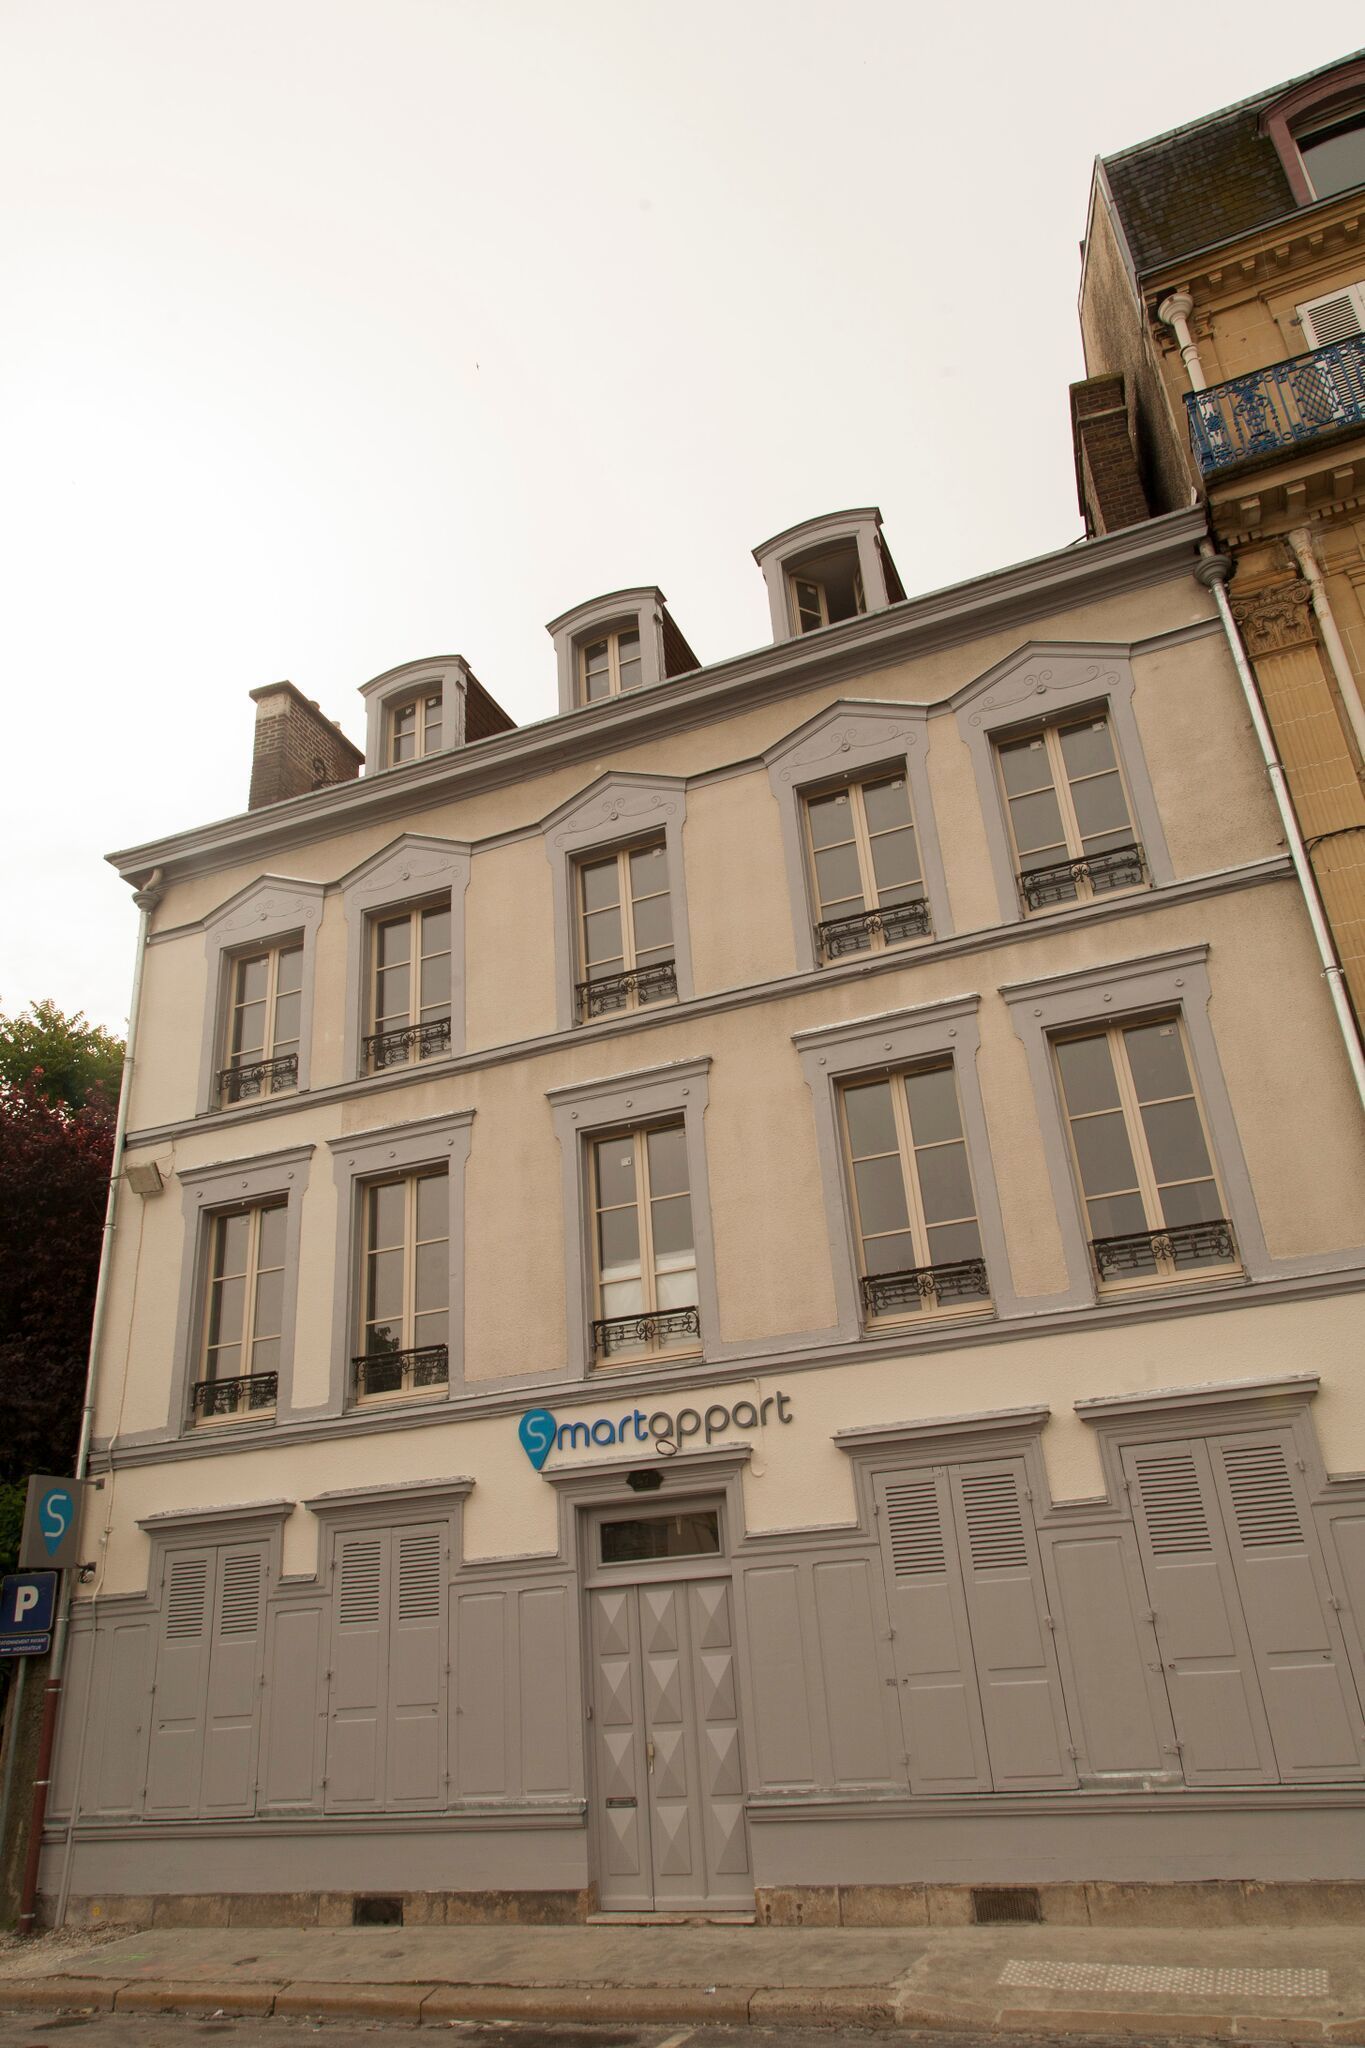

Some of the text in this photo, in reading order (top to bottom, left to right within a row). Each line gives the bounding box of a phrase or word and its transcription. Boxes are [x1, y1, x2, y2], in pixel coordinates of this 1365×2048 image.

[524, 1391, 793, 1453] Smartappart
[44, 1494, 67, 1537] S
[14, 1585, 39, 1623] P
